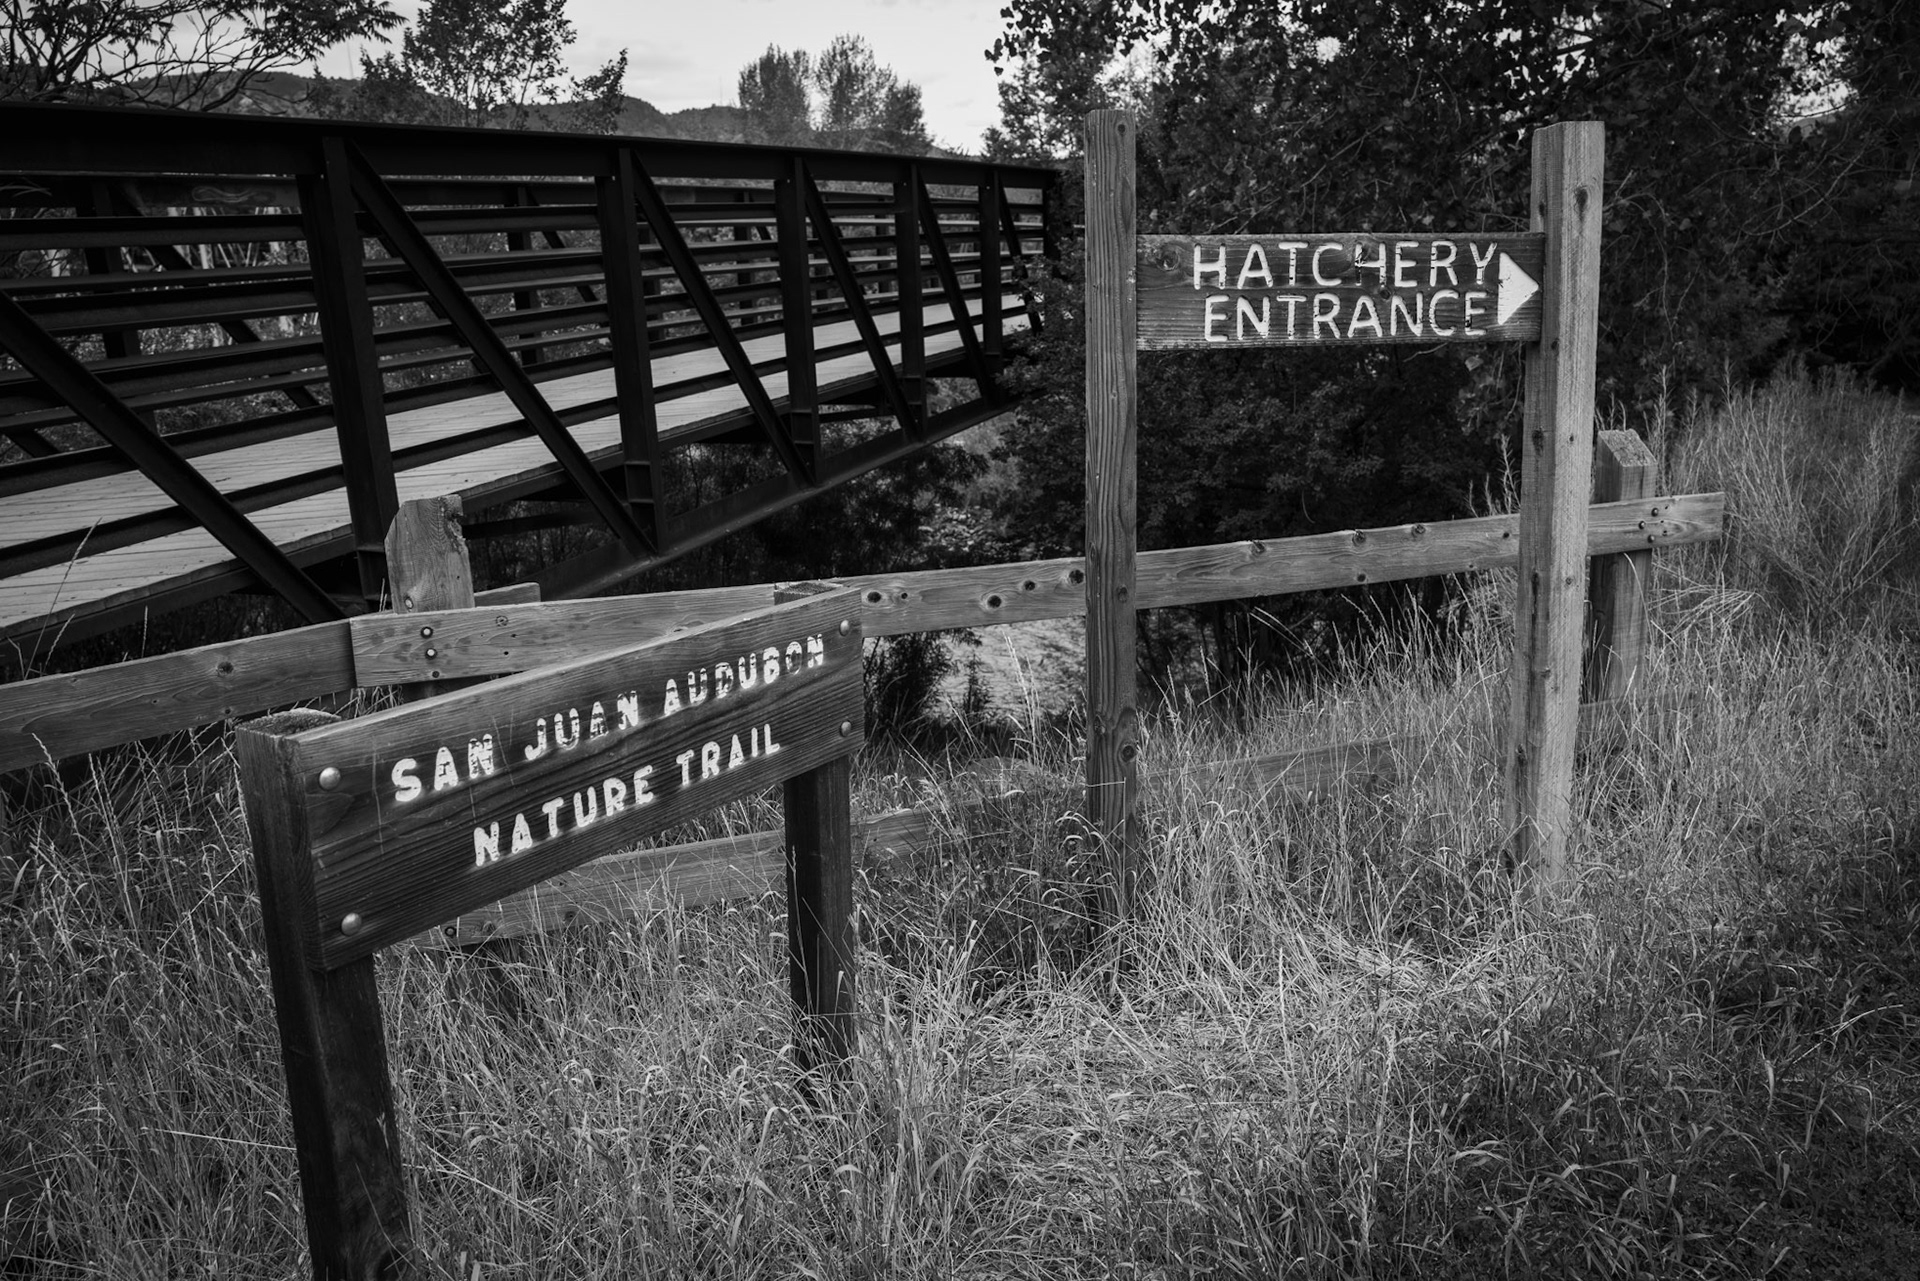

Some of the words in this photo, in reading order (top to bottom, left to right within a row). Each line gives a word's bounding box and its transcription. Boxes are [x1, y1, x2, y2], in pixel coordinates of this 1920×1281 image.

[1193, 240, 1498, 290] HATCHERY
[1204, 289, 1489, 342] ENTRANCE
[391, 733, 495, 802] SAN
[524, 690, 639, 760] JUAN
[664, 633, 825, 717] AUDUBON
[473, 764, 655, 867] NATURE
[676, 723, 780, 787] TRAIL
